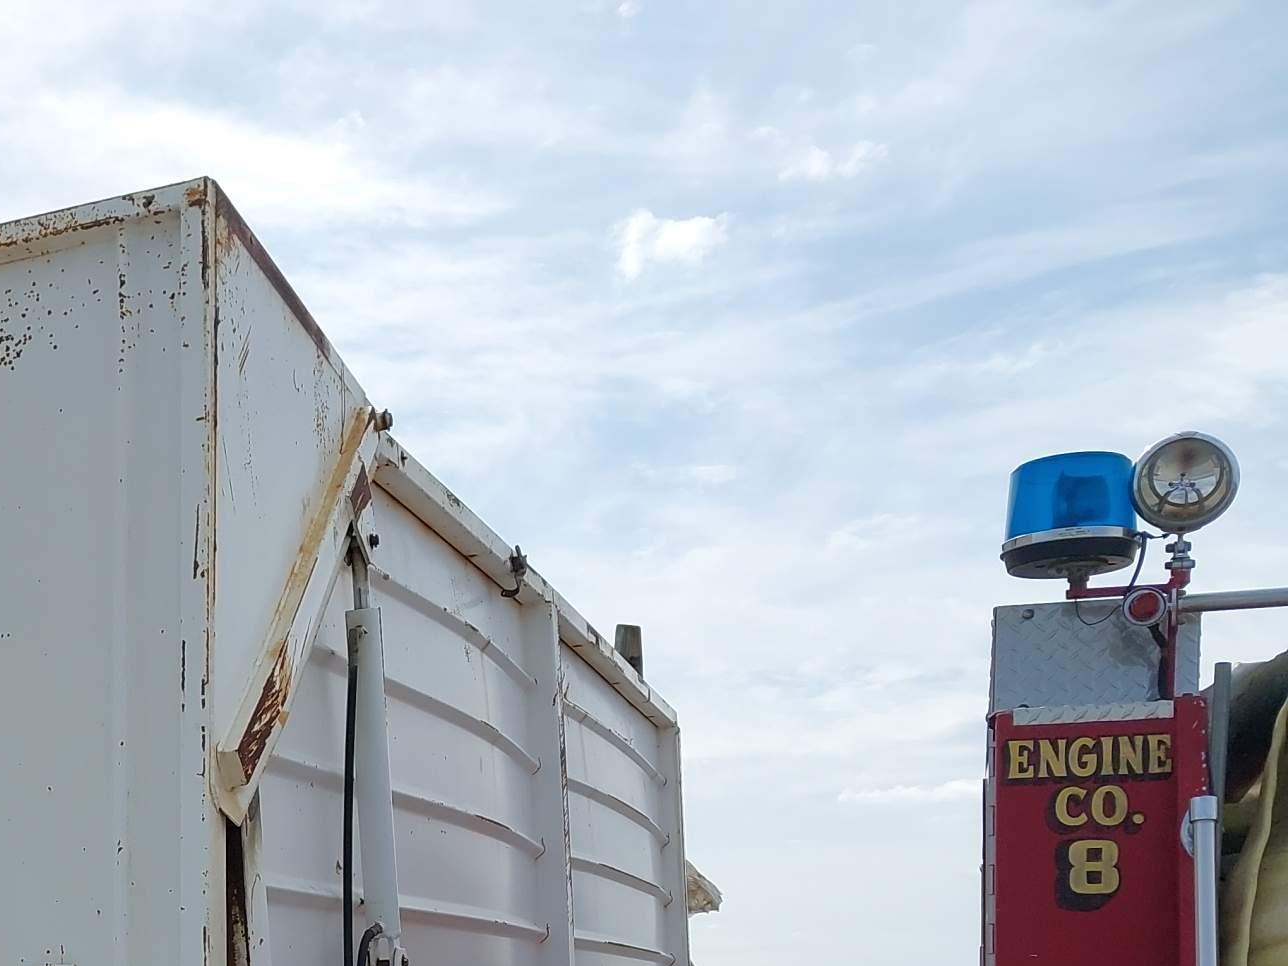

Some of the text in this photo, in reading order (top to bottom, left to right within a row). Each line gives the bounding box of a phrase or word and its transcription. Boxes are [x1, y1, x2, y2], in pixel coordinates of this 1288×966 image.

[1007, 734, 1173, 780] ENGINE
[1055, 785, 1145, 826] CO.
[1068, 839, 1120, 895] 8
